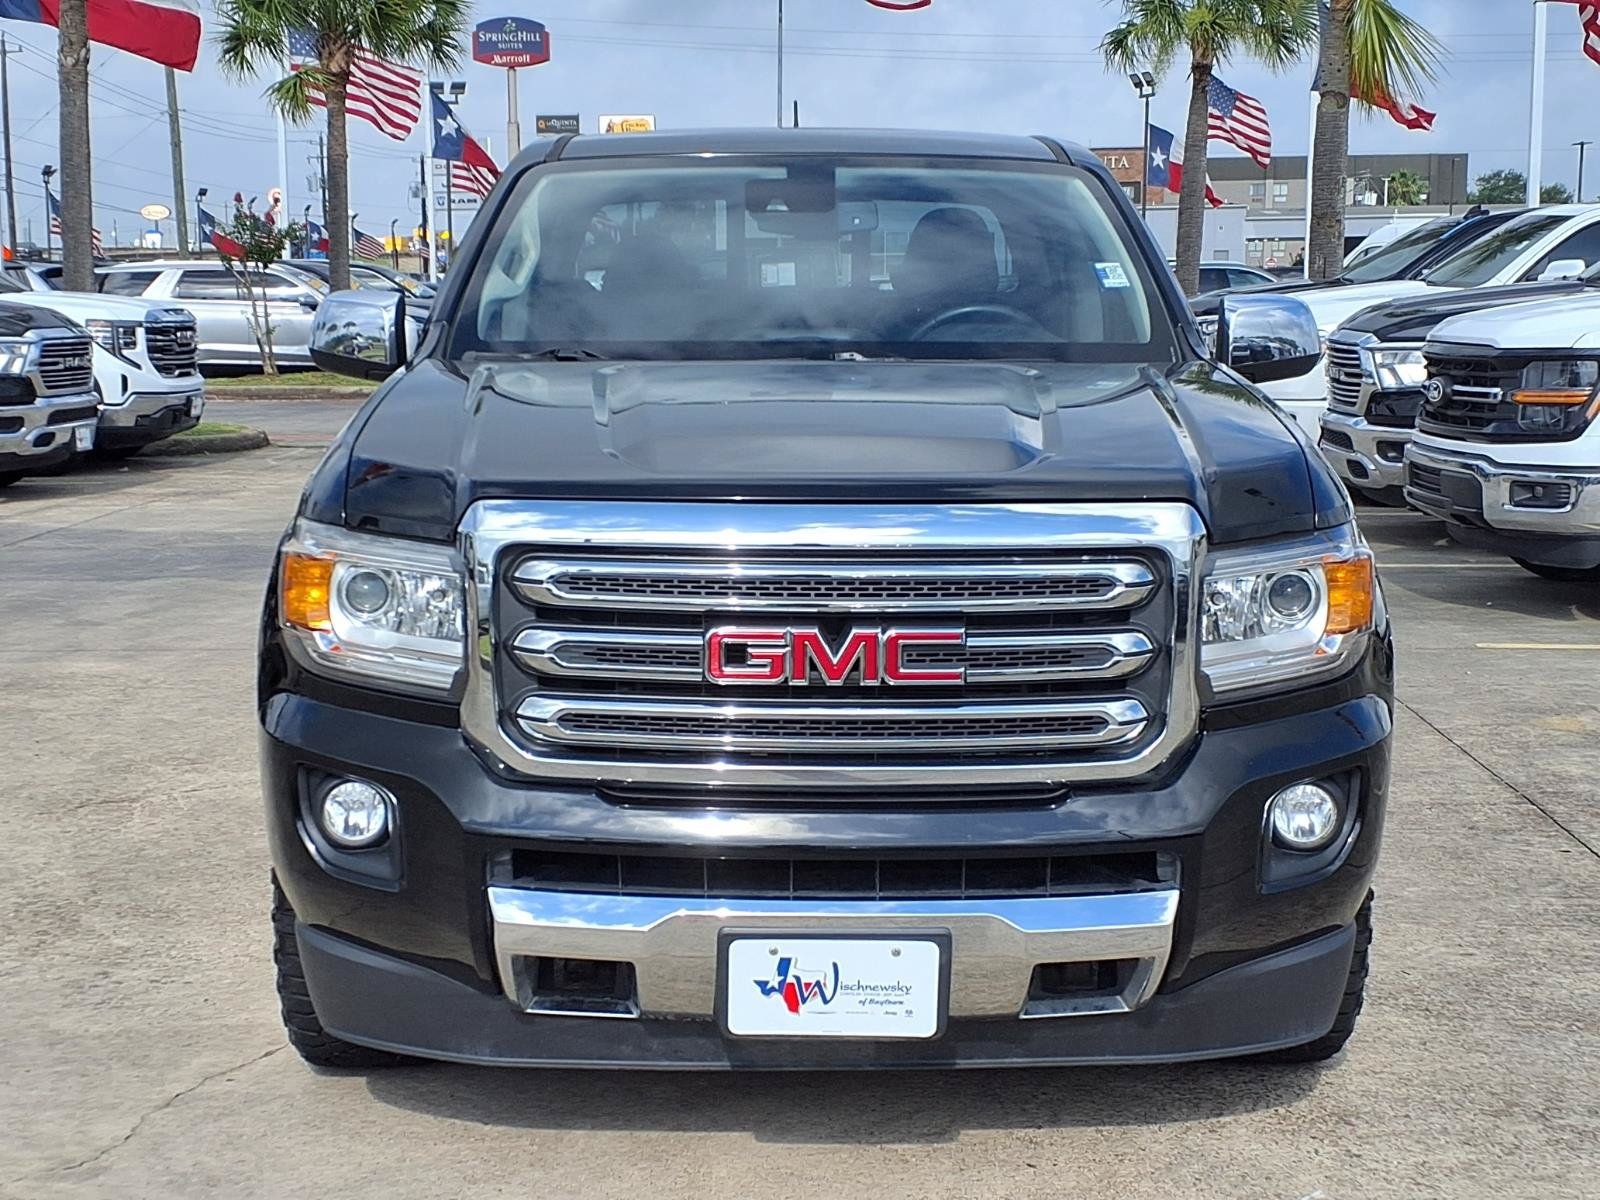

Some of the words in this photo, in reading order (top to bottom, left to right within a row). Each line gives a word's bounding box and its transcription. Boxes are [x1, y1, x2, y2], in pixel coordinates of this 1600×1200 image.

[491, 54, 531, 64] Marriott
[705, 626, 967, 686] GMC
[792, 961, 912, 1006] Wischnewsky
